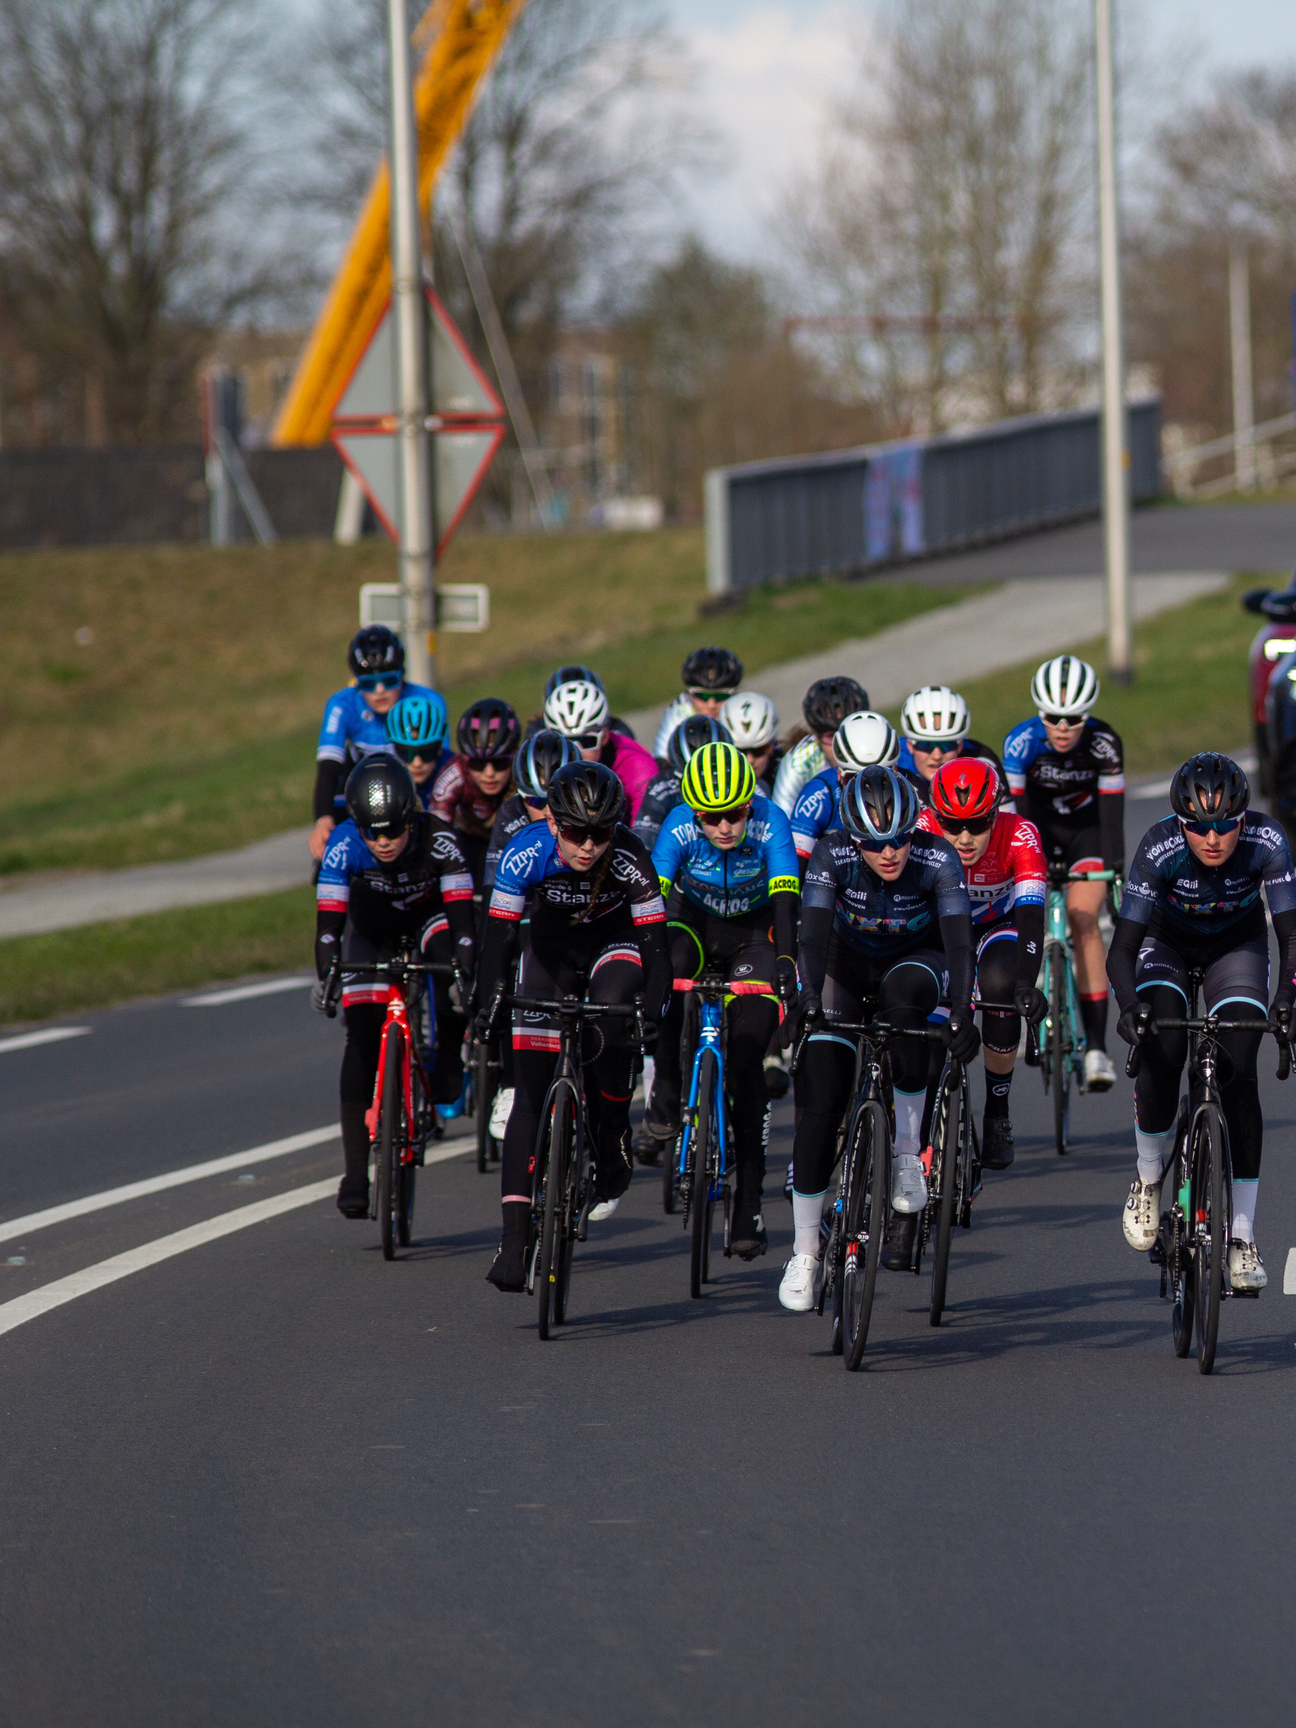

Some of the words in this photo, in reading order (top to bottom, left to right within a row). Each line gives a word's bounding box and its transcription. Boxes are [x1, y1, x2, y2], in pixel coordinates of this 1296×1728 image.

[773, 879, 796, 891] ACROG
[969, 880, 1015, 899] anza
[636, 914, 665, 923] STERN
